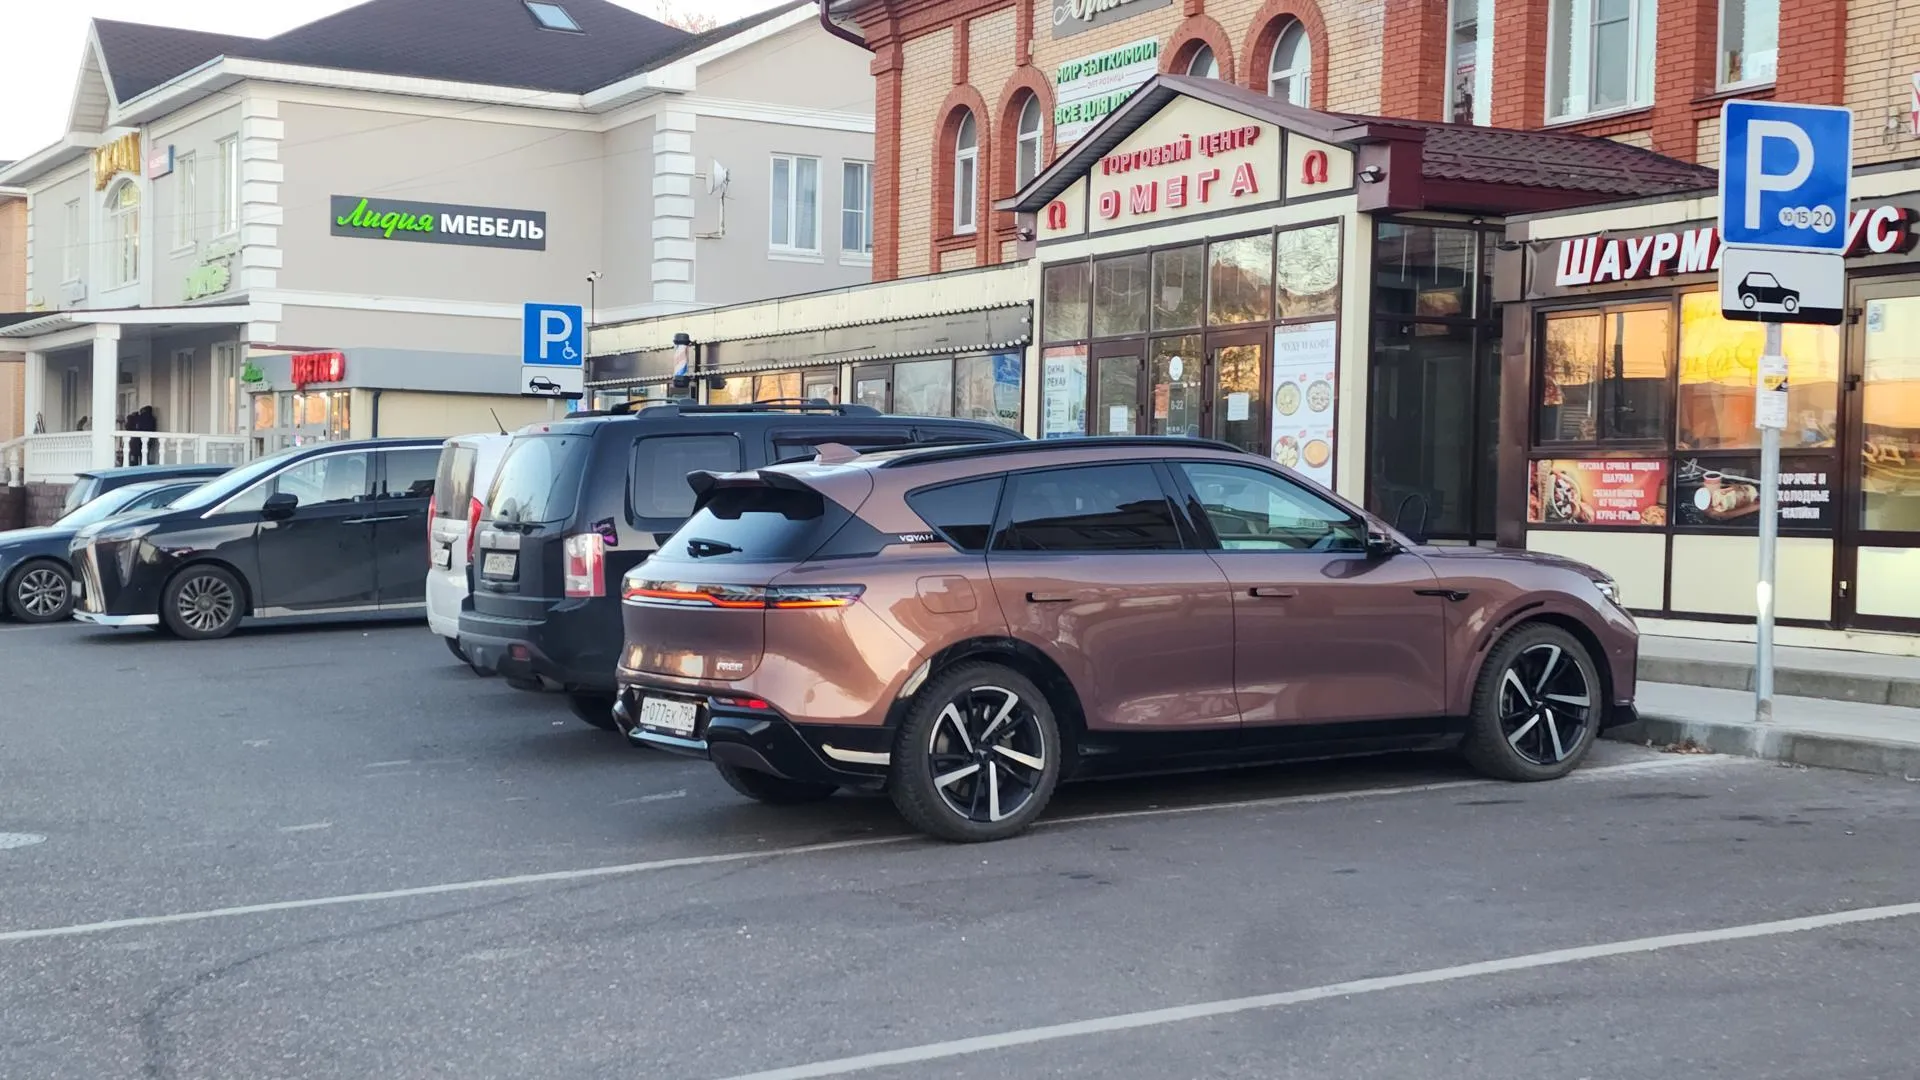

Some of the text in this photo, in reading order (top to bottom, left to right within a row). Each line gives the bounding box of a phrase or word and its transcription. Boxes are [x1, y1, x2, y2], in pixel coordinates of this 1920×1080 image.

[1055, 103, 1081, 125] ВСЕ
[1081, 93, 1111, 123] ДЛЯ
[1101, 126, 1261, 176] ТОРГОВЫЙ ЦЕНТР
[1744, 119, 1815, 230] P
[1099, 162, 1259, 220] ОМЕГА
[336, 198, 544, 240] Лидия МЕБЕЛЬ
[1783, 210, 1833, 228] 10 15 20
[540, 310, 573, 359] P
